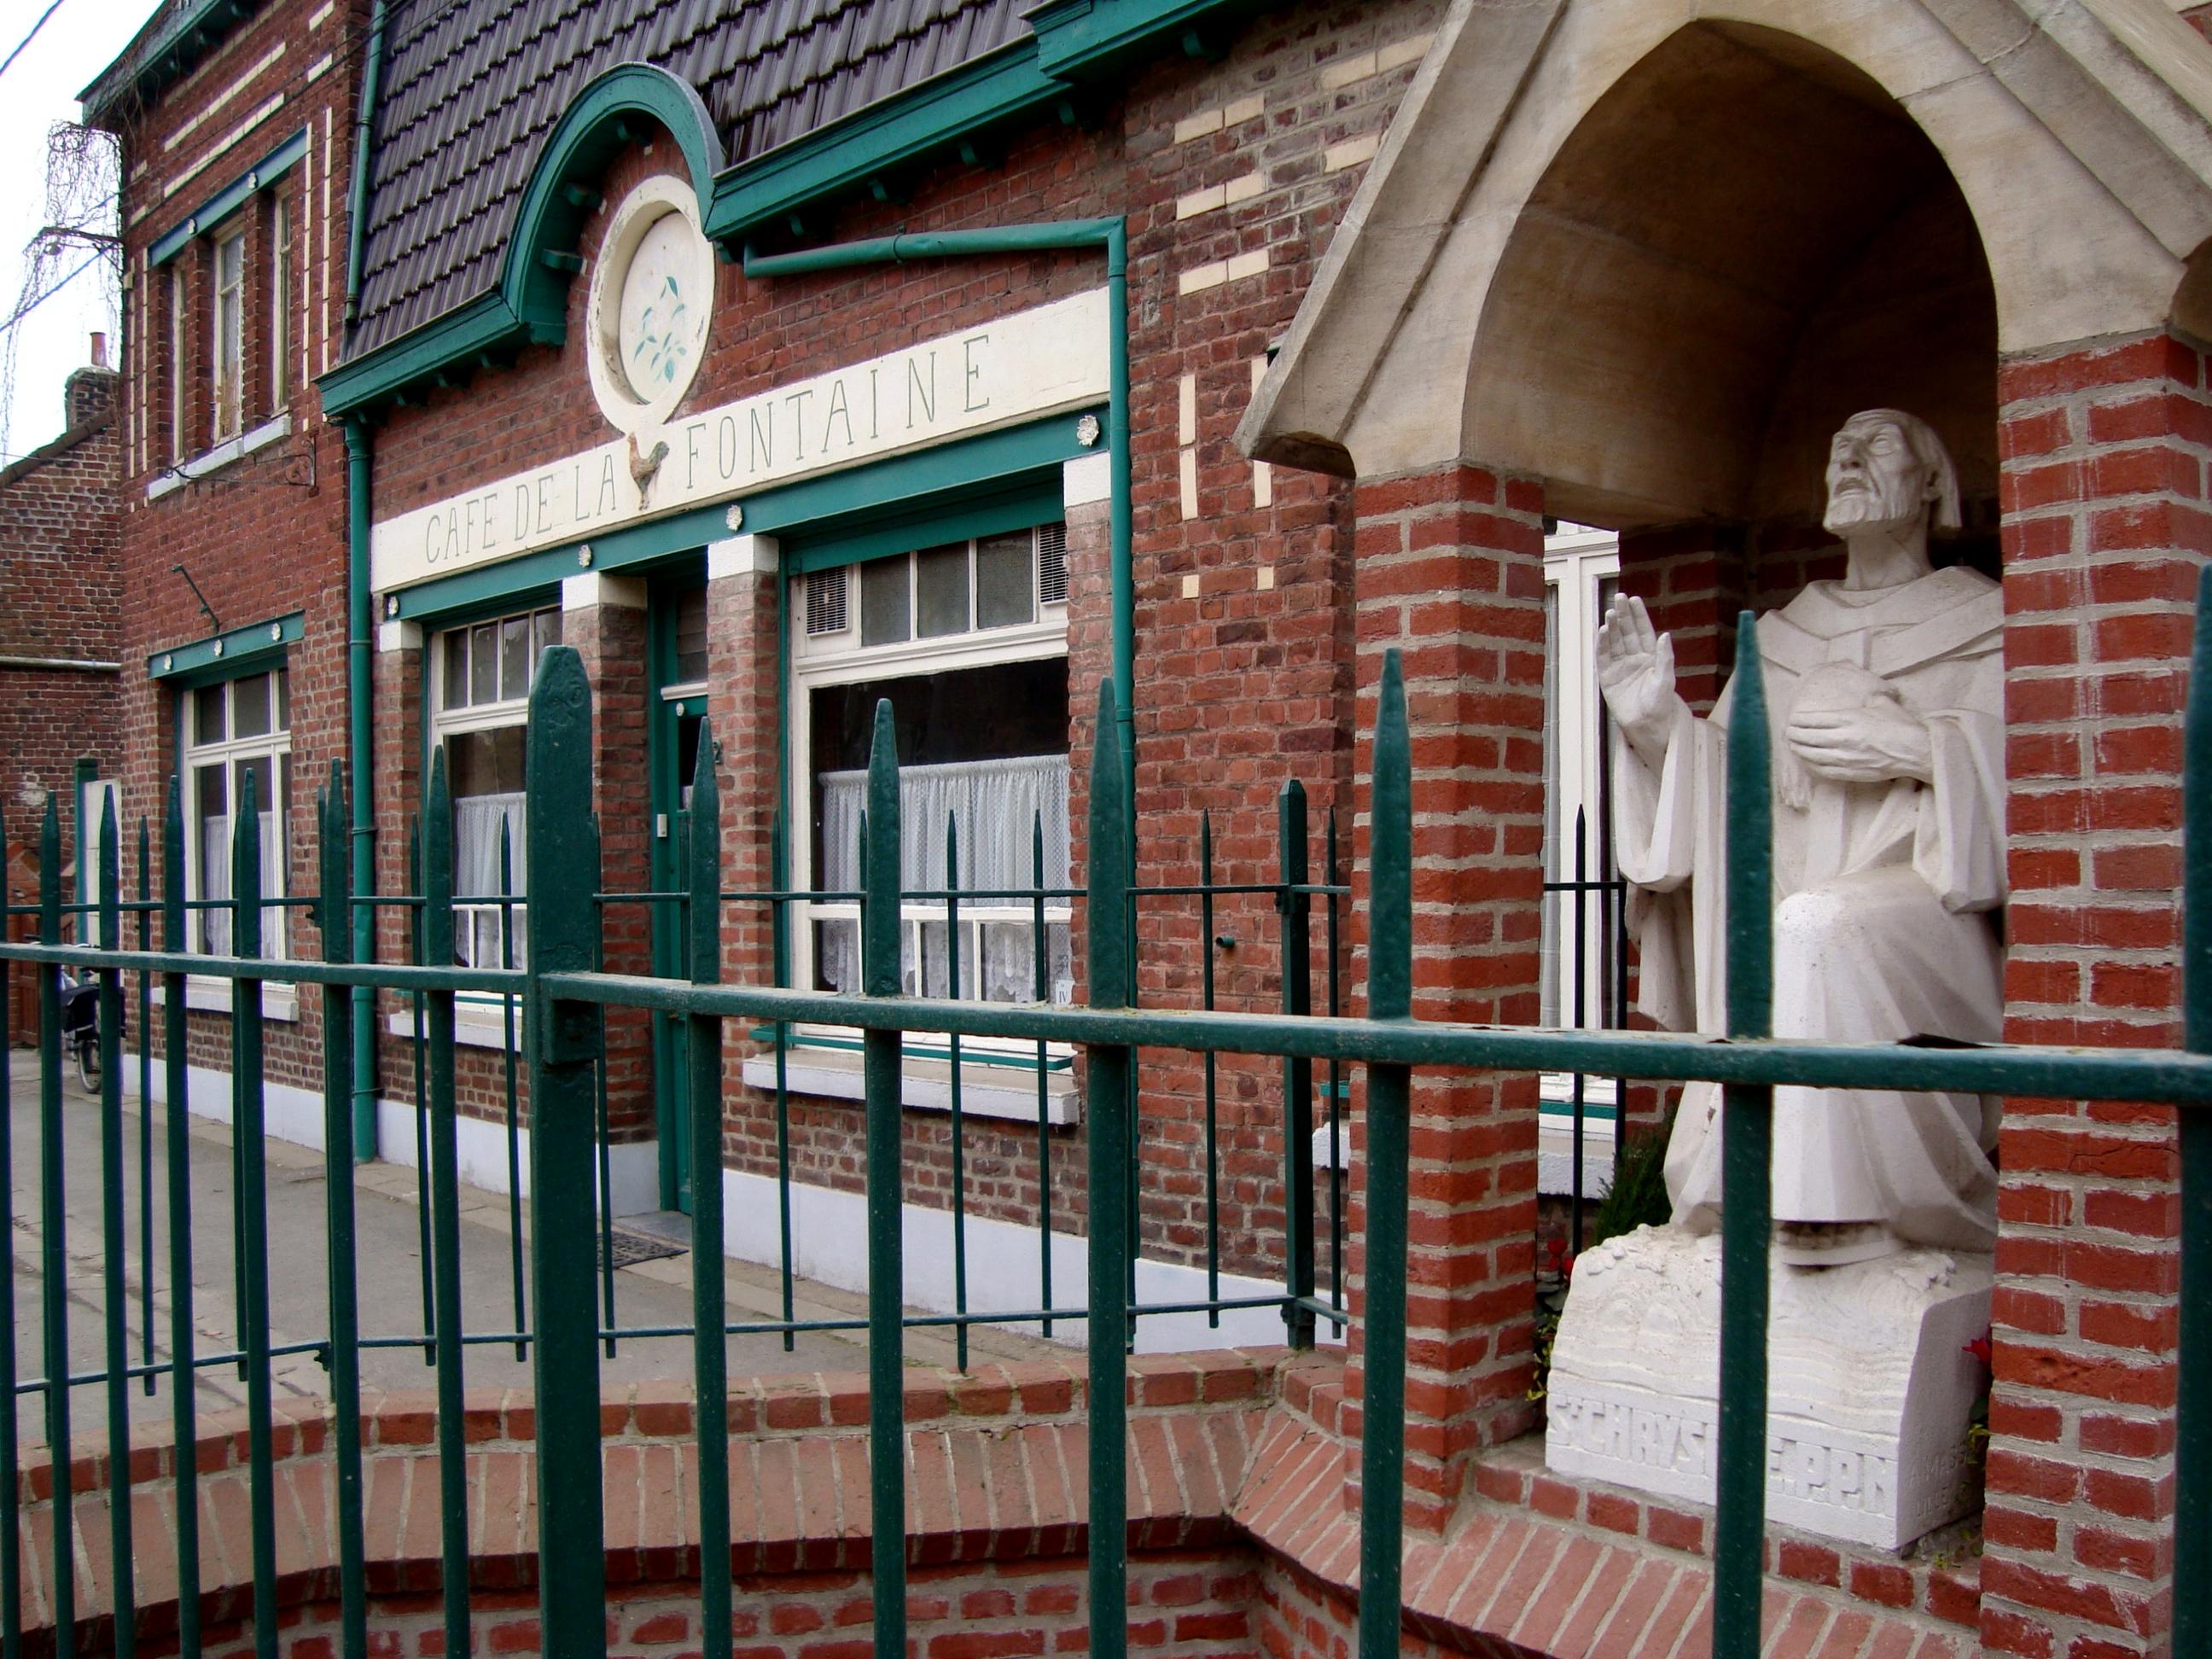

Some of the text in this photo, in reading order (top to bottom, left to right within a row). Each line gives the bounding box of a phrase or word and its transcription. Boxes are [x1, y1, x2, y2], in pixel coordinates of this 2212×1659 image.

[426, 334, 990, 564] CAFE DE LA FONTAINE
